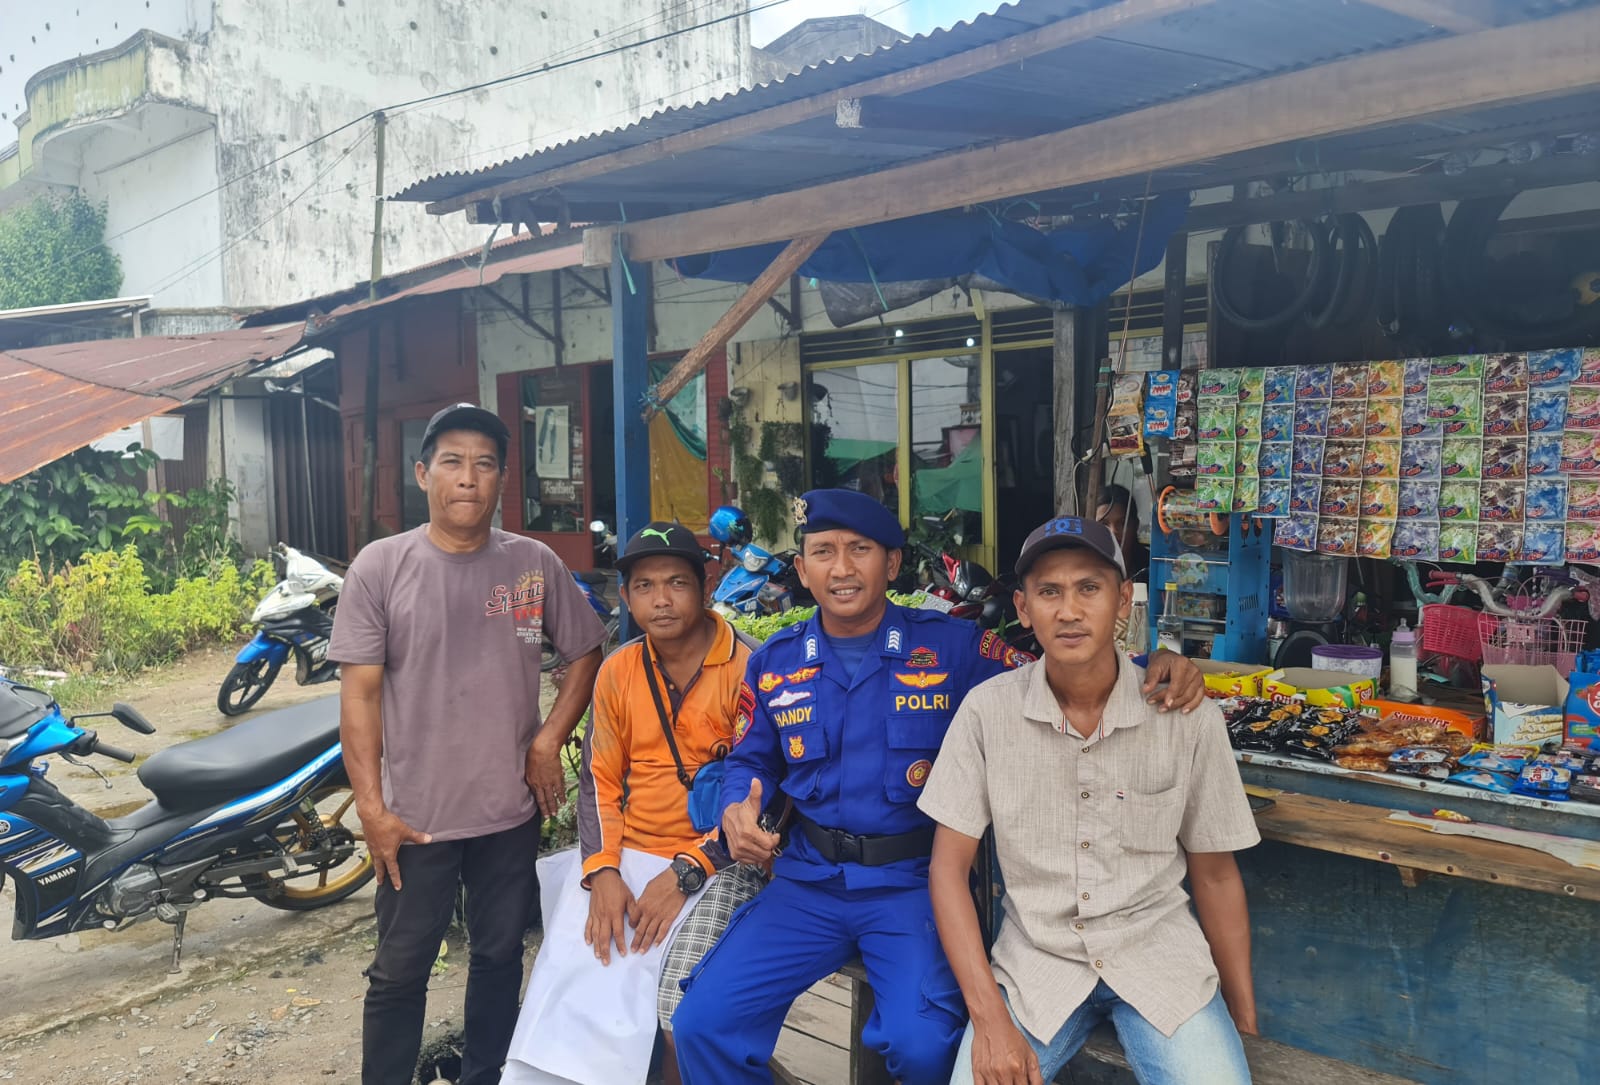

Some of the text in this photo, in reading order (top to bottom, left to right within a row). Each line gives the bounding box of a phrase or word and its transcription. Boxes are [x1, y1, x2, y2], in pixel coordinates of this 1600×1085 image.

[895, 693, 950, 711] POLRI
[774, 706, 812, 728] HANDY
[37, 866, 77, 886] YAMAHA
